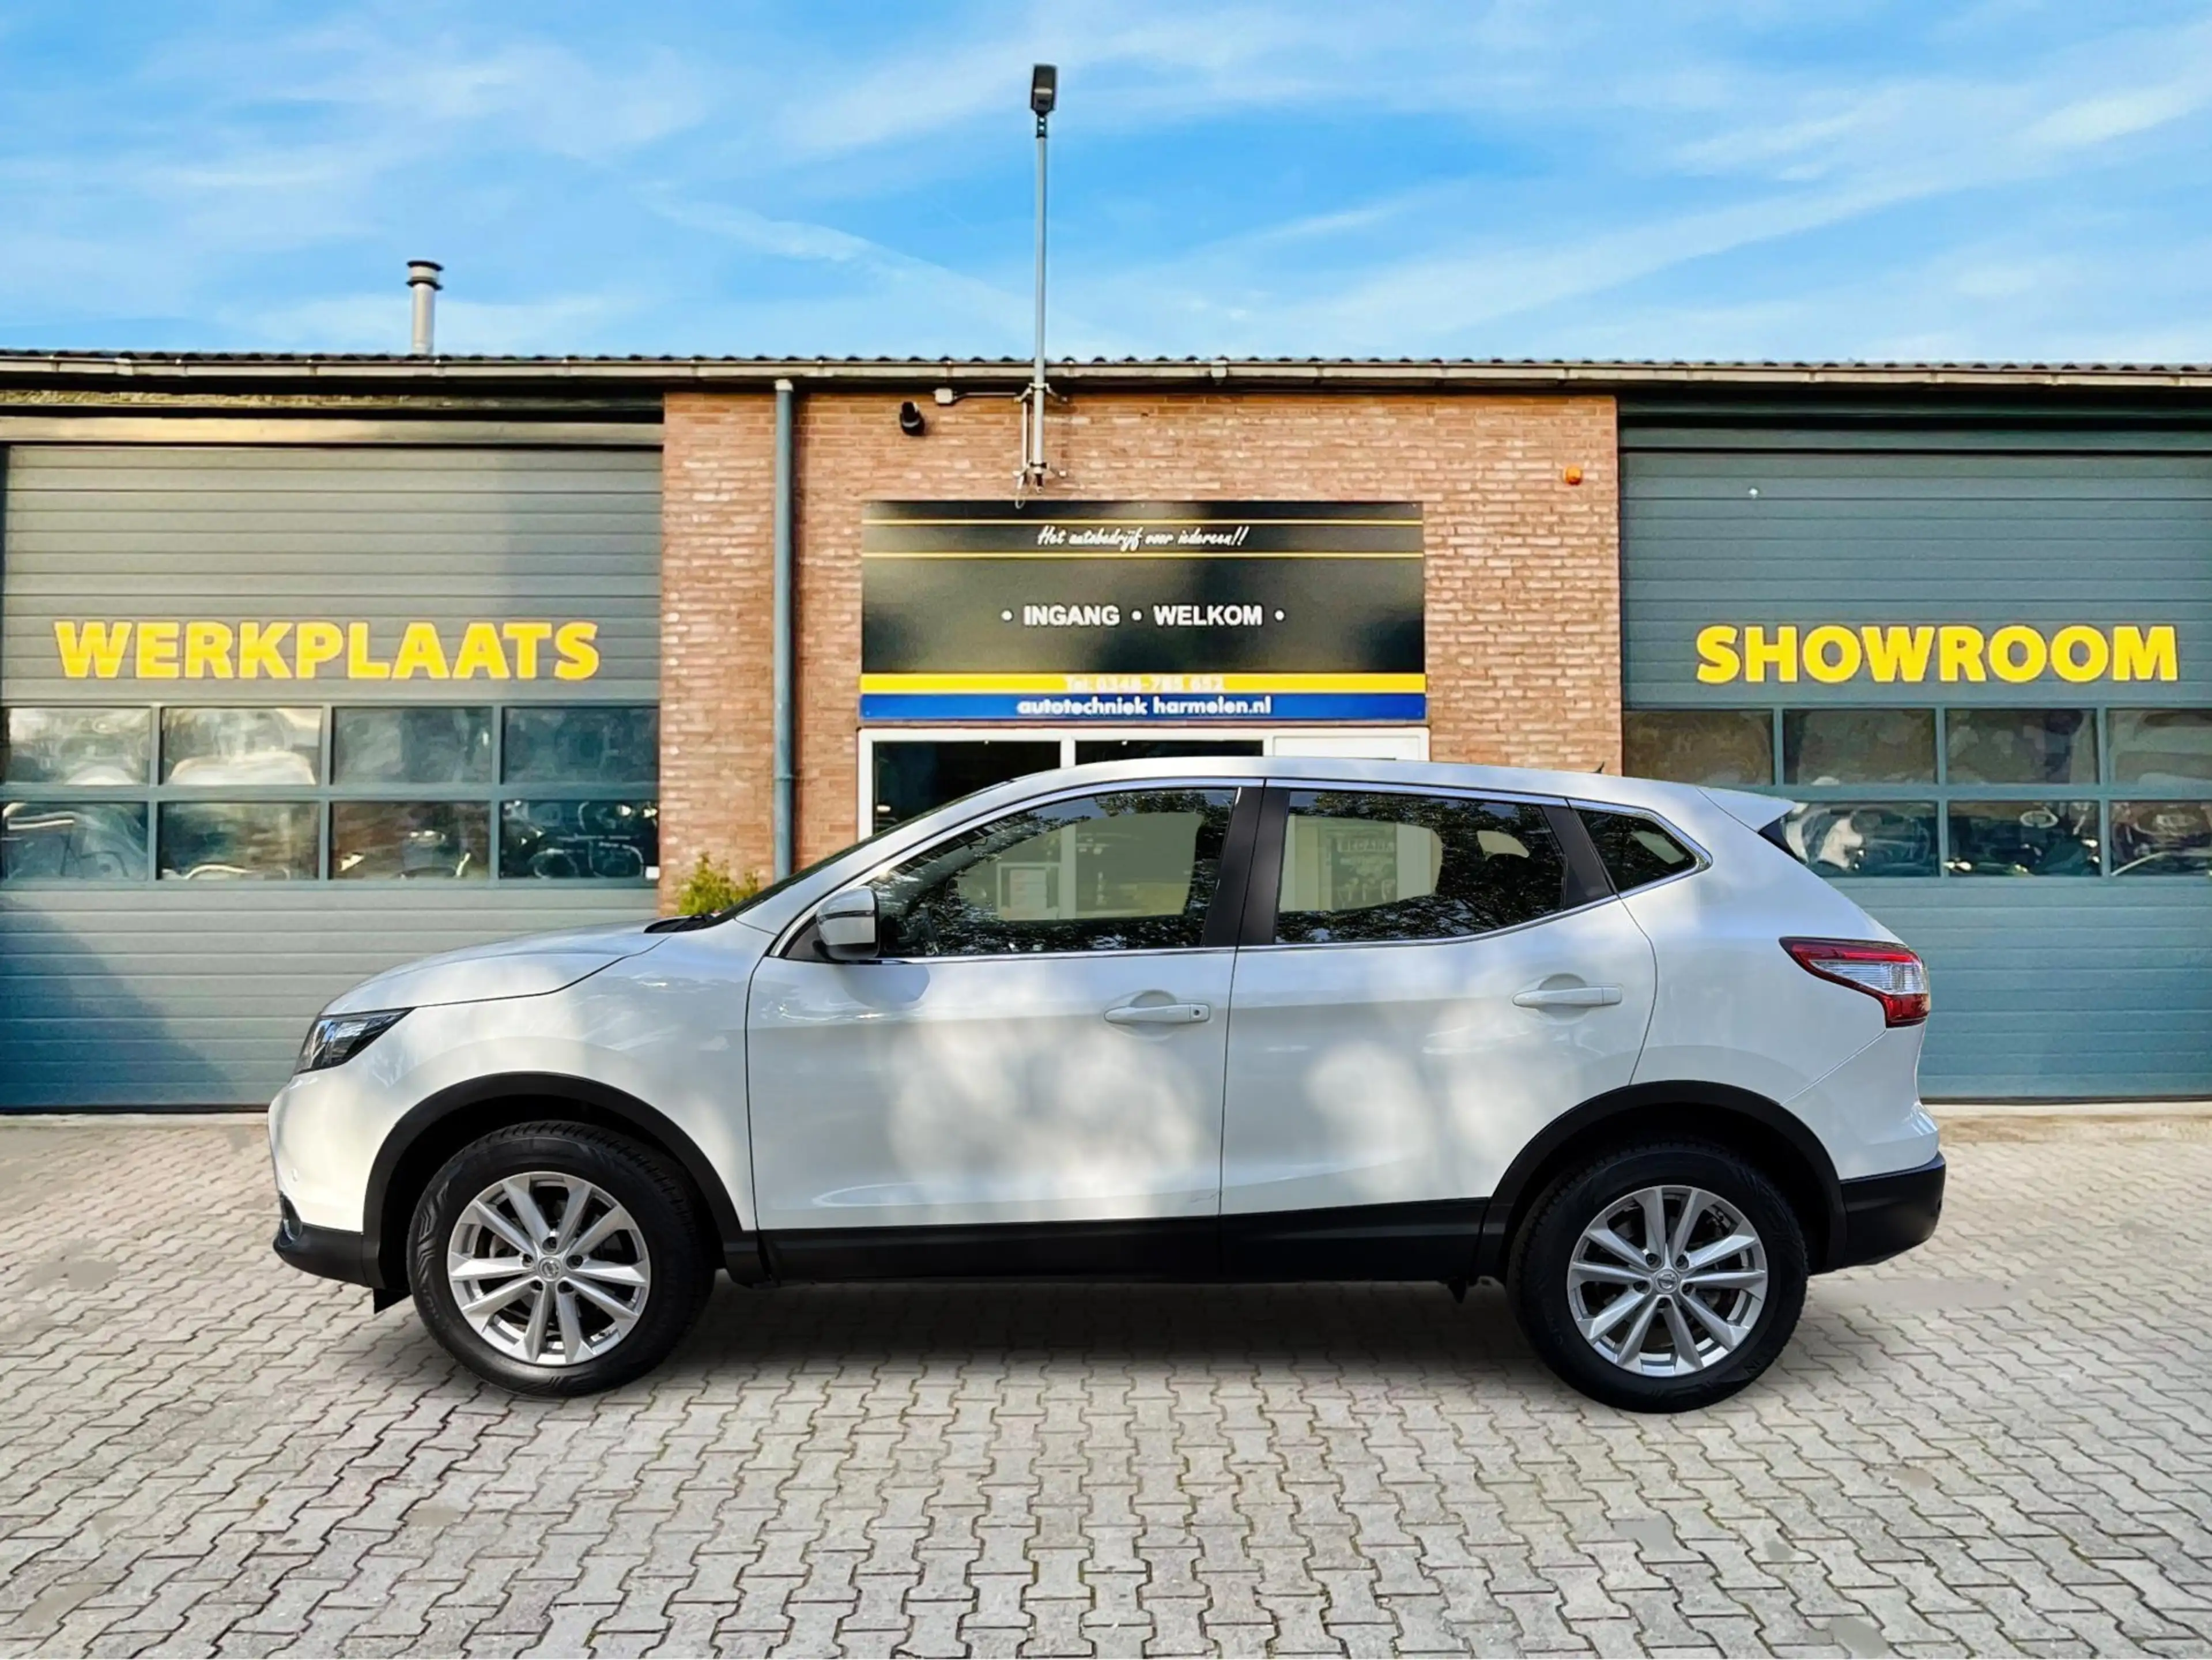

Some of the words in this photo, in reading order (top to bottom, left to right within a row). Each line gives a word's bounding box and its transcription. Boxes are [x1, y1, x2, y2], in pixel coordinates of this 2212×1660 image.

[1038, 526, 1066, 544] Het
[1024, 605, 1119, 625] INGANG
[1154, 606, 1262, 625] WELKOM
[54, 621, 599, 680] WERKPLAATS
[1696, 625, 2179, 684] SHOWROOM
[1017, 696, 1147, 714] autotechniek
[1154, 696, 1270, 713] harmelen.nl
